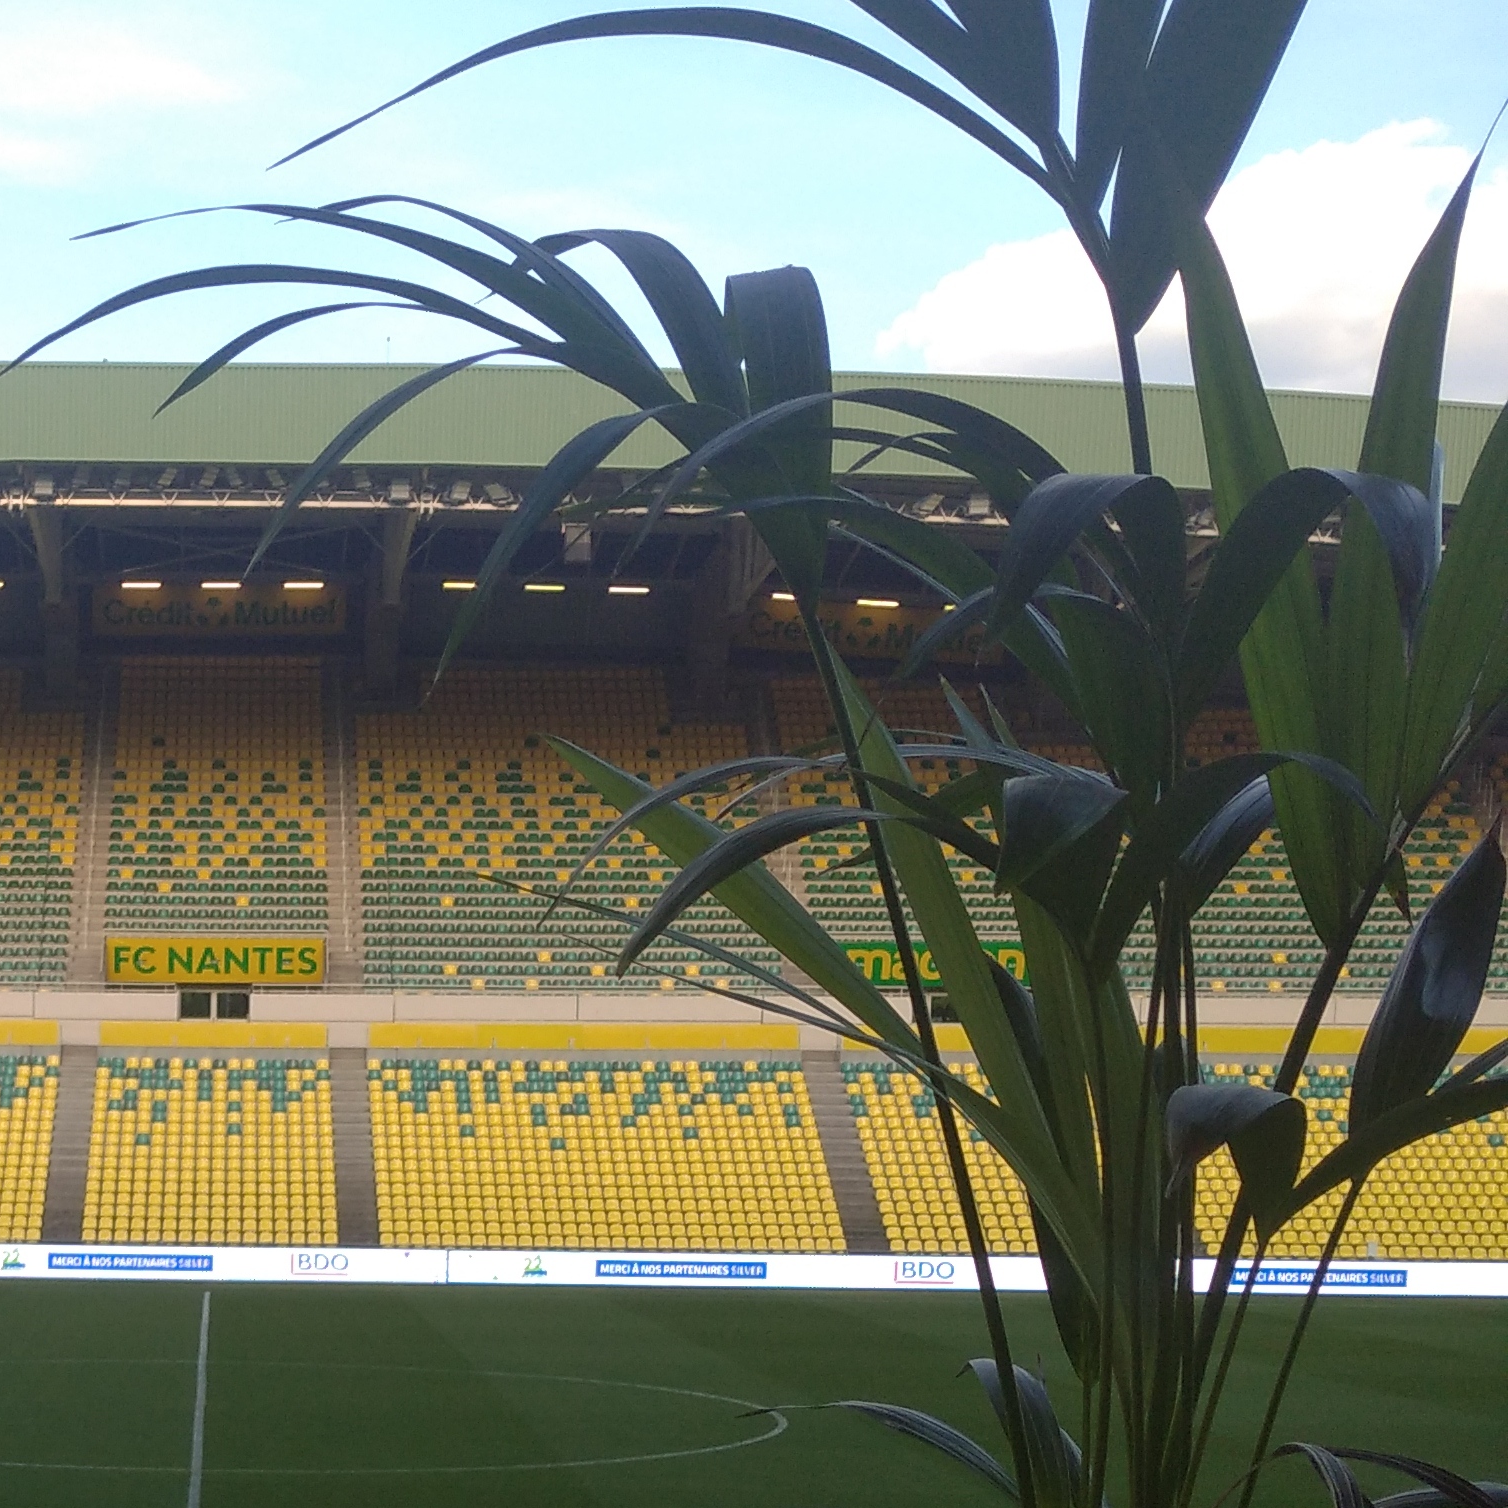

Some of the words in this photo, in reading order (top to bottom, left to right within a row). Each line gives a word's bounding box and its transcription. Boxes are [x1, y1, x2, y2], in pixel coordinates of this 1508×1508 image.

[103, 598, 193, 626] Crédit
[235, 598, 336, 625] Mutuel
[114, 946, 156, 974] FC
[168, 946, 317, 975] NANTES
[52, 1256, 82, 1266] MERCI
[91, 1256, 112, 1267] NOS
[113, 1257, 177, 1268] PARTENAIRES
[298, 1254, 349, 1270] BDO
[600, 1264, 630, 1274] MERCI
[641, 1264, 661, 1275] NOS
[663, 1264, 729, 1275] PARTENAIRES
[731, 1265, 763, 1276] SILVER
[902, 1261, 955, 1279] BDO
[1277, 1271, 1298, 1282] NOS
[1370, 1273, 1404, 1284] SILVER
